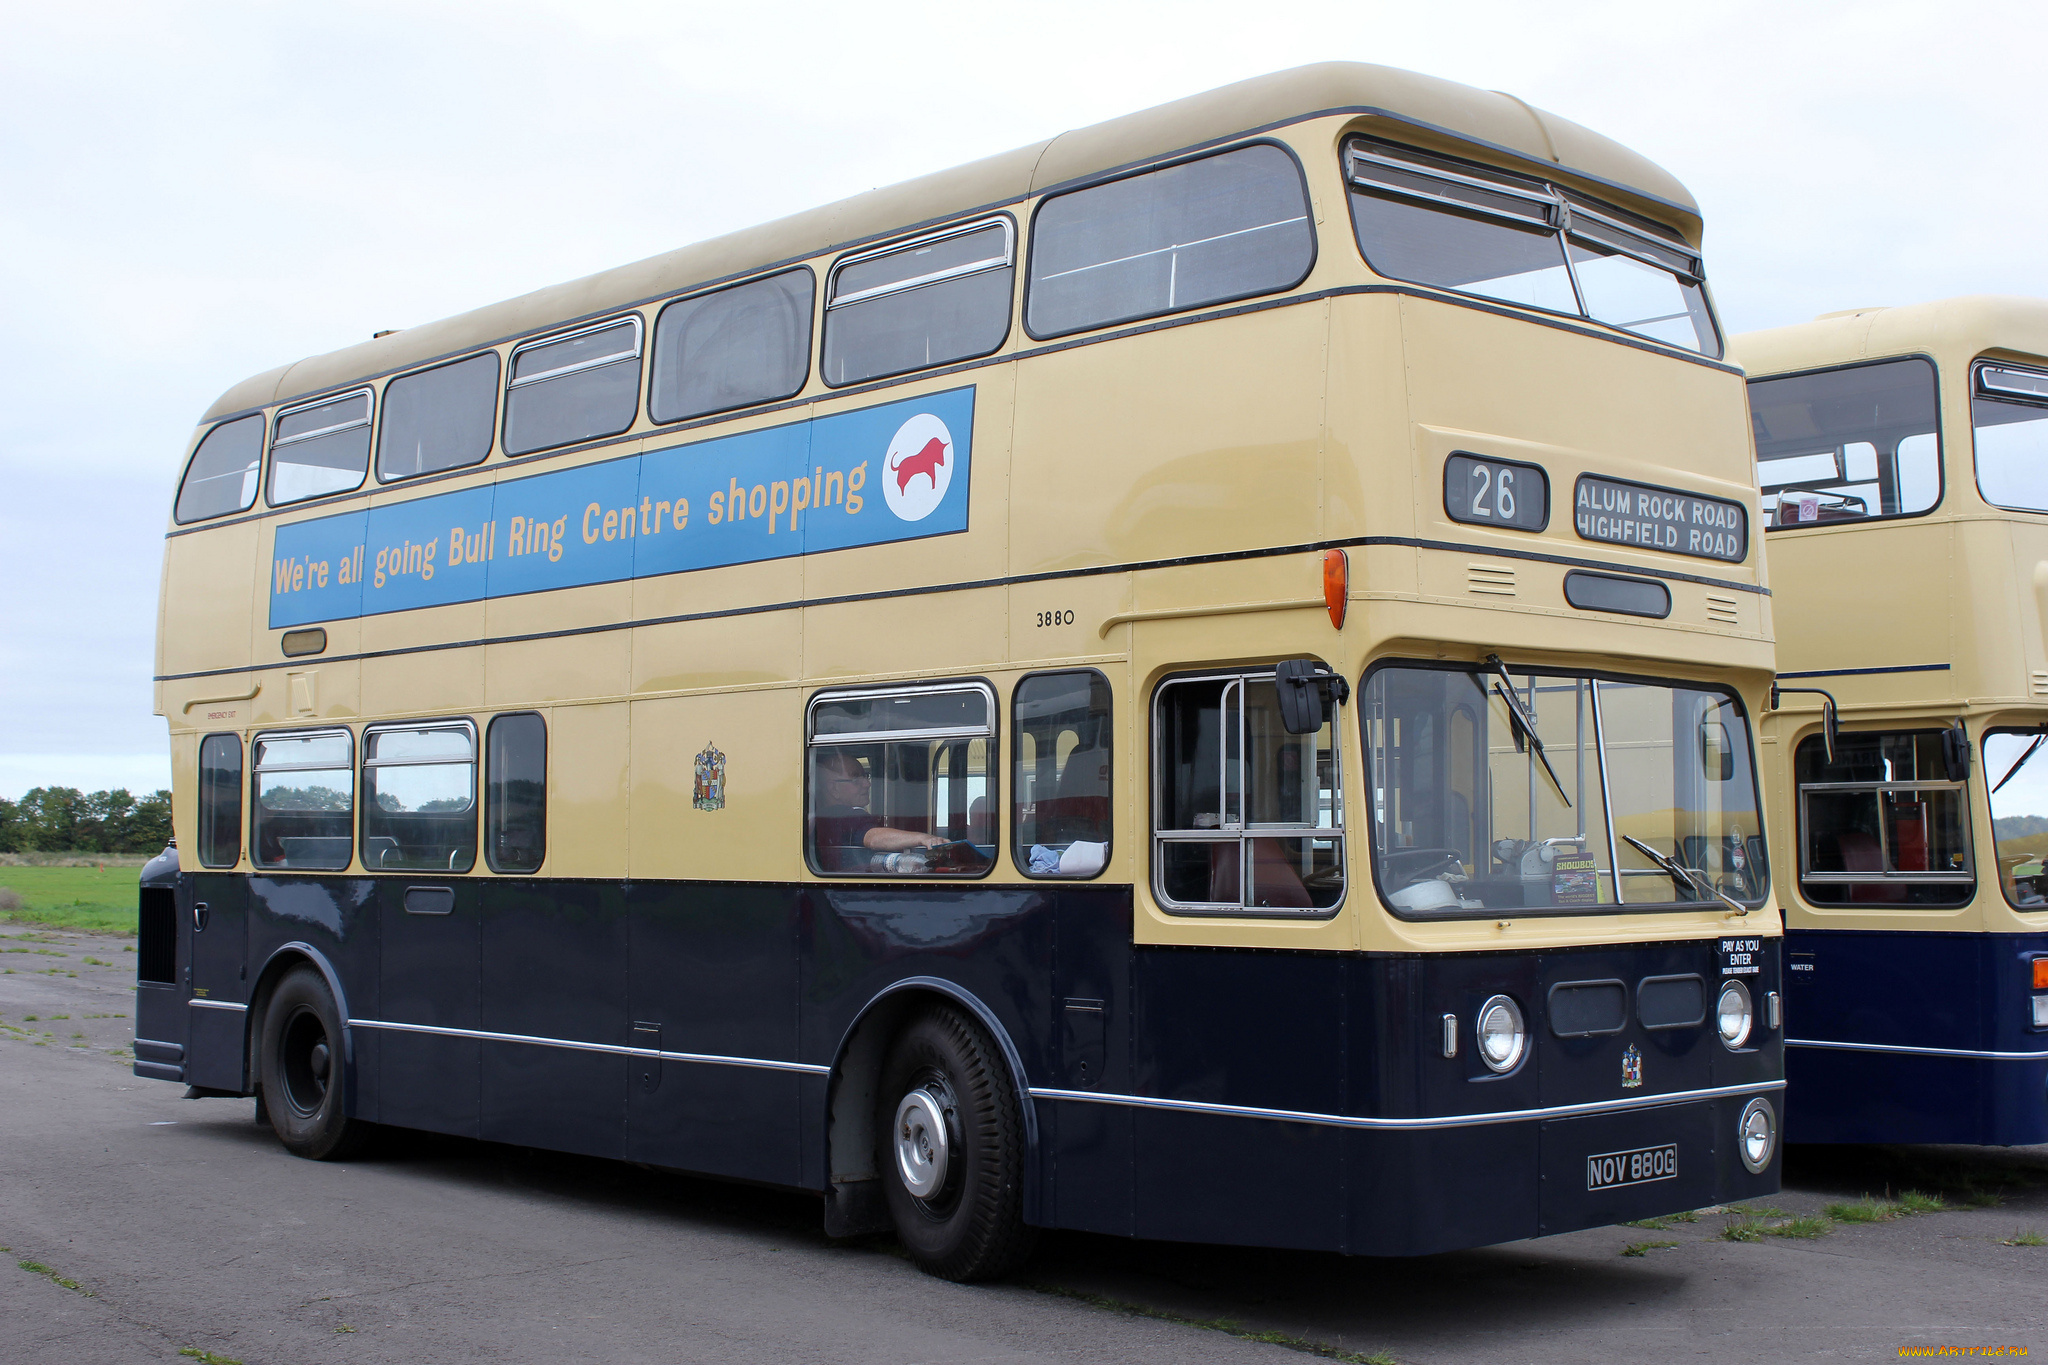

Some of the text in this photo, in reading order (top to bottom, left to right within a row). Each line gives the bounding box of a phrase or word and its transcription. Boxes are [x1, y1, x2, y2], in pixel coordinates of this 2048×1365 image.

[1472, 464, 1516, 519] 26
[1577, 484, 1738, 530] ALUM ROCK ROAD
[275, 460, 868, 594] We're all going Bull Ring Centre shopping
[1577, 513, 1738, 557] HIGHFIELD ROAD
[1036, 609, 1075, 628] 3880
[1722, 940, 1760, 953] PAY AS YOU
[1730, 953, 1752, 966] ENTER
[1790, 963, 1814, 972] WATER
[1590, 1149, 1675, 1186] NOV 880G
